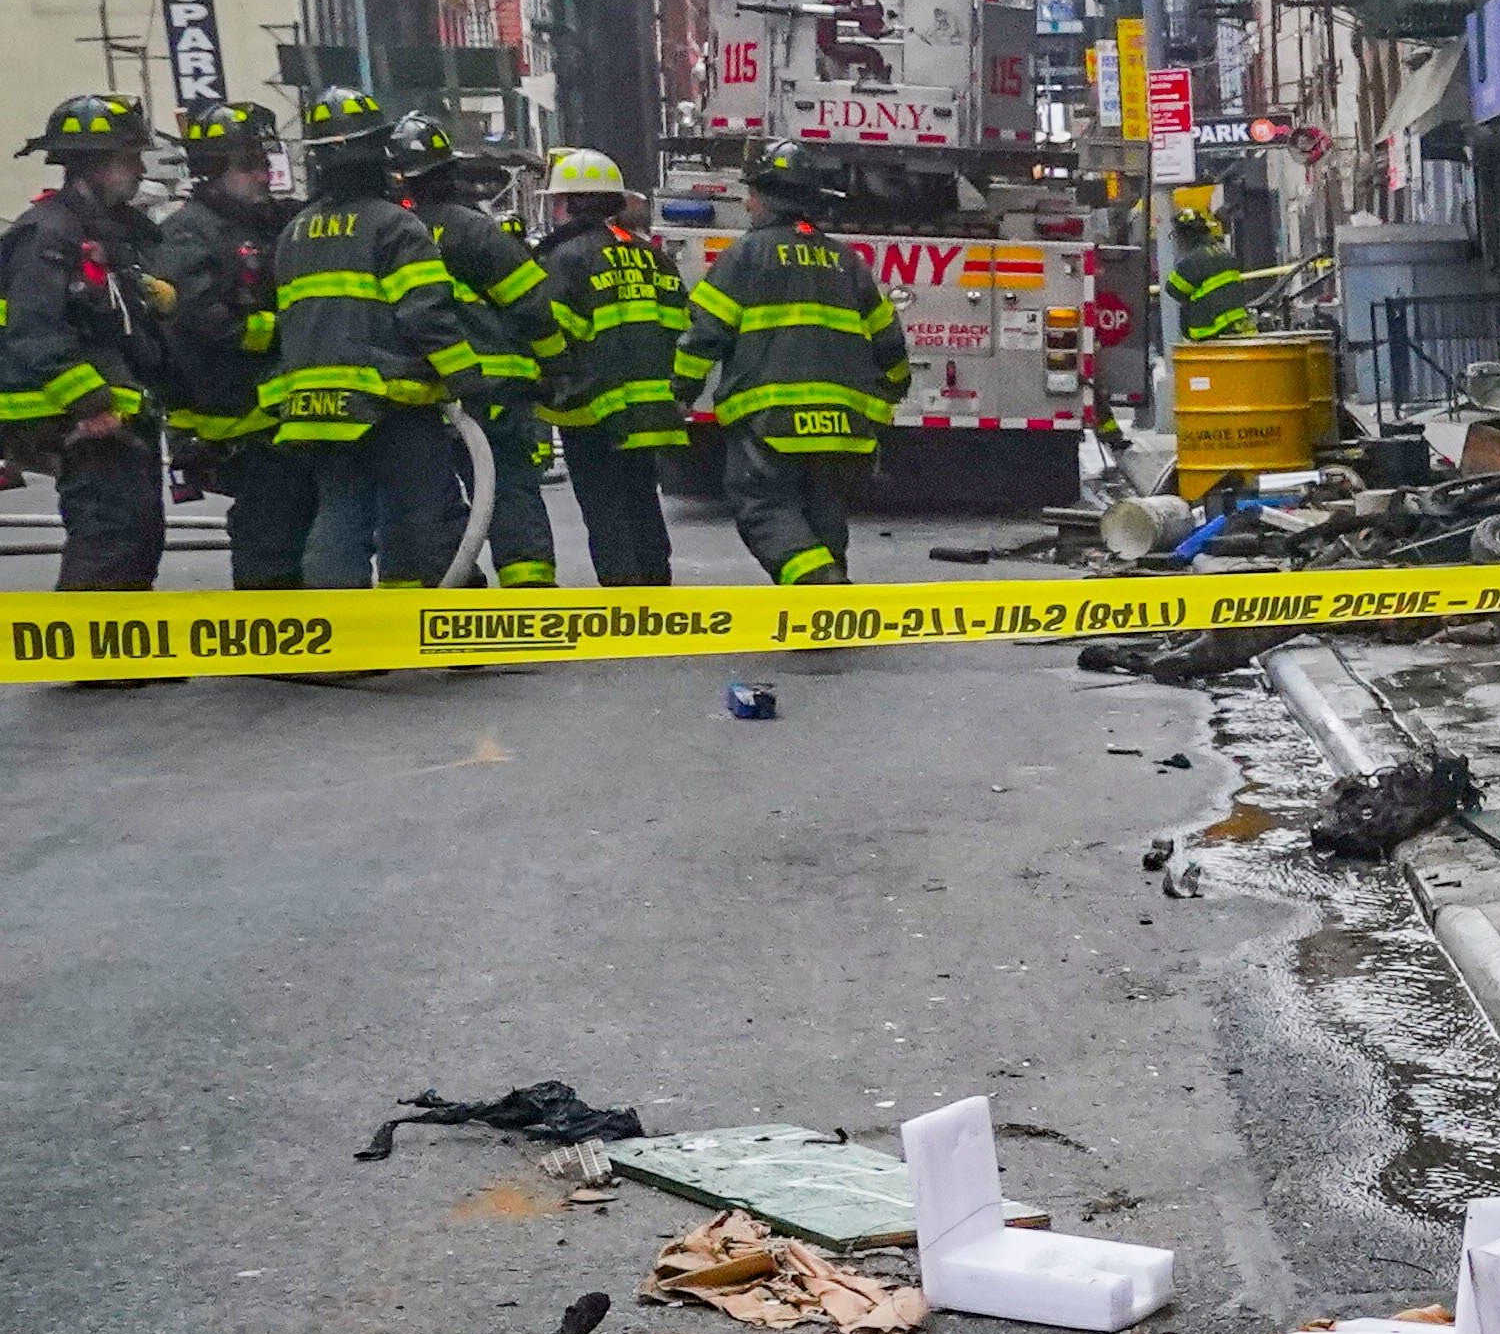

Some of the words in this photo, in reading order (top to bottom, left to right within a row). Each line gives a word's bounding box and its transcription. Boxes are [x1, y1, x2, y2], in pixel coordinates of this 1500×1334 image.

[168, 3, 223, 100] PARK
[724, 42, 759, 85] 115
[990, 56, 1024, 98] 115
[818, 100, 933, 132] F.D.N.Y.
[1191, 123, 1250, 143] PARK
[849, 242, 962, 288] DNY
[907, 323, 947, 336] KEEP
[949, 323, 990, 337] BACK
[1098, 311, 1129, 329] OP
[915, 335, 944, 348] 200
[947, 335, 983, 348] FEET
[794, 410, 851, 436] COSTA
